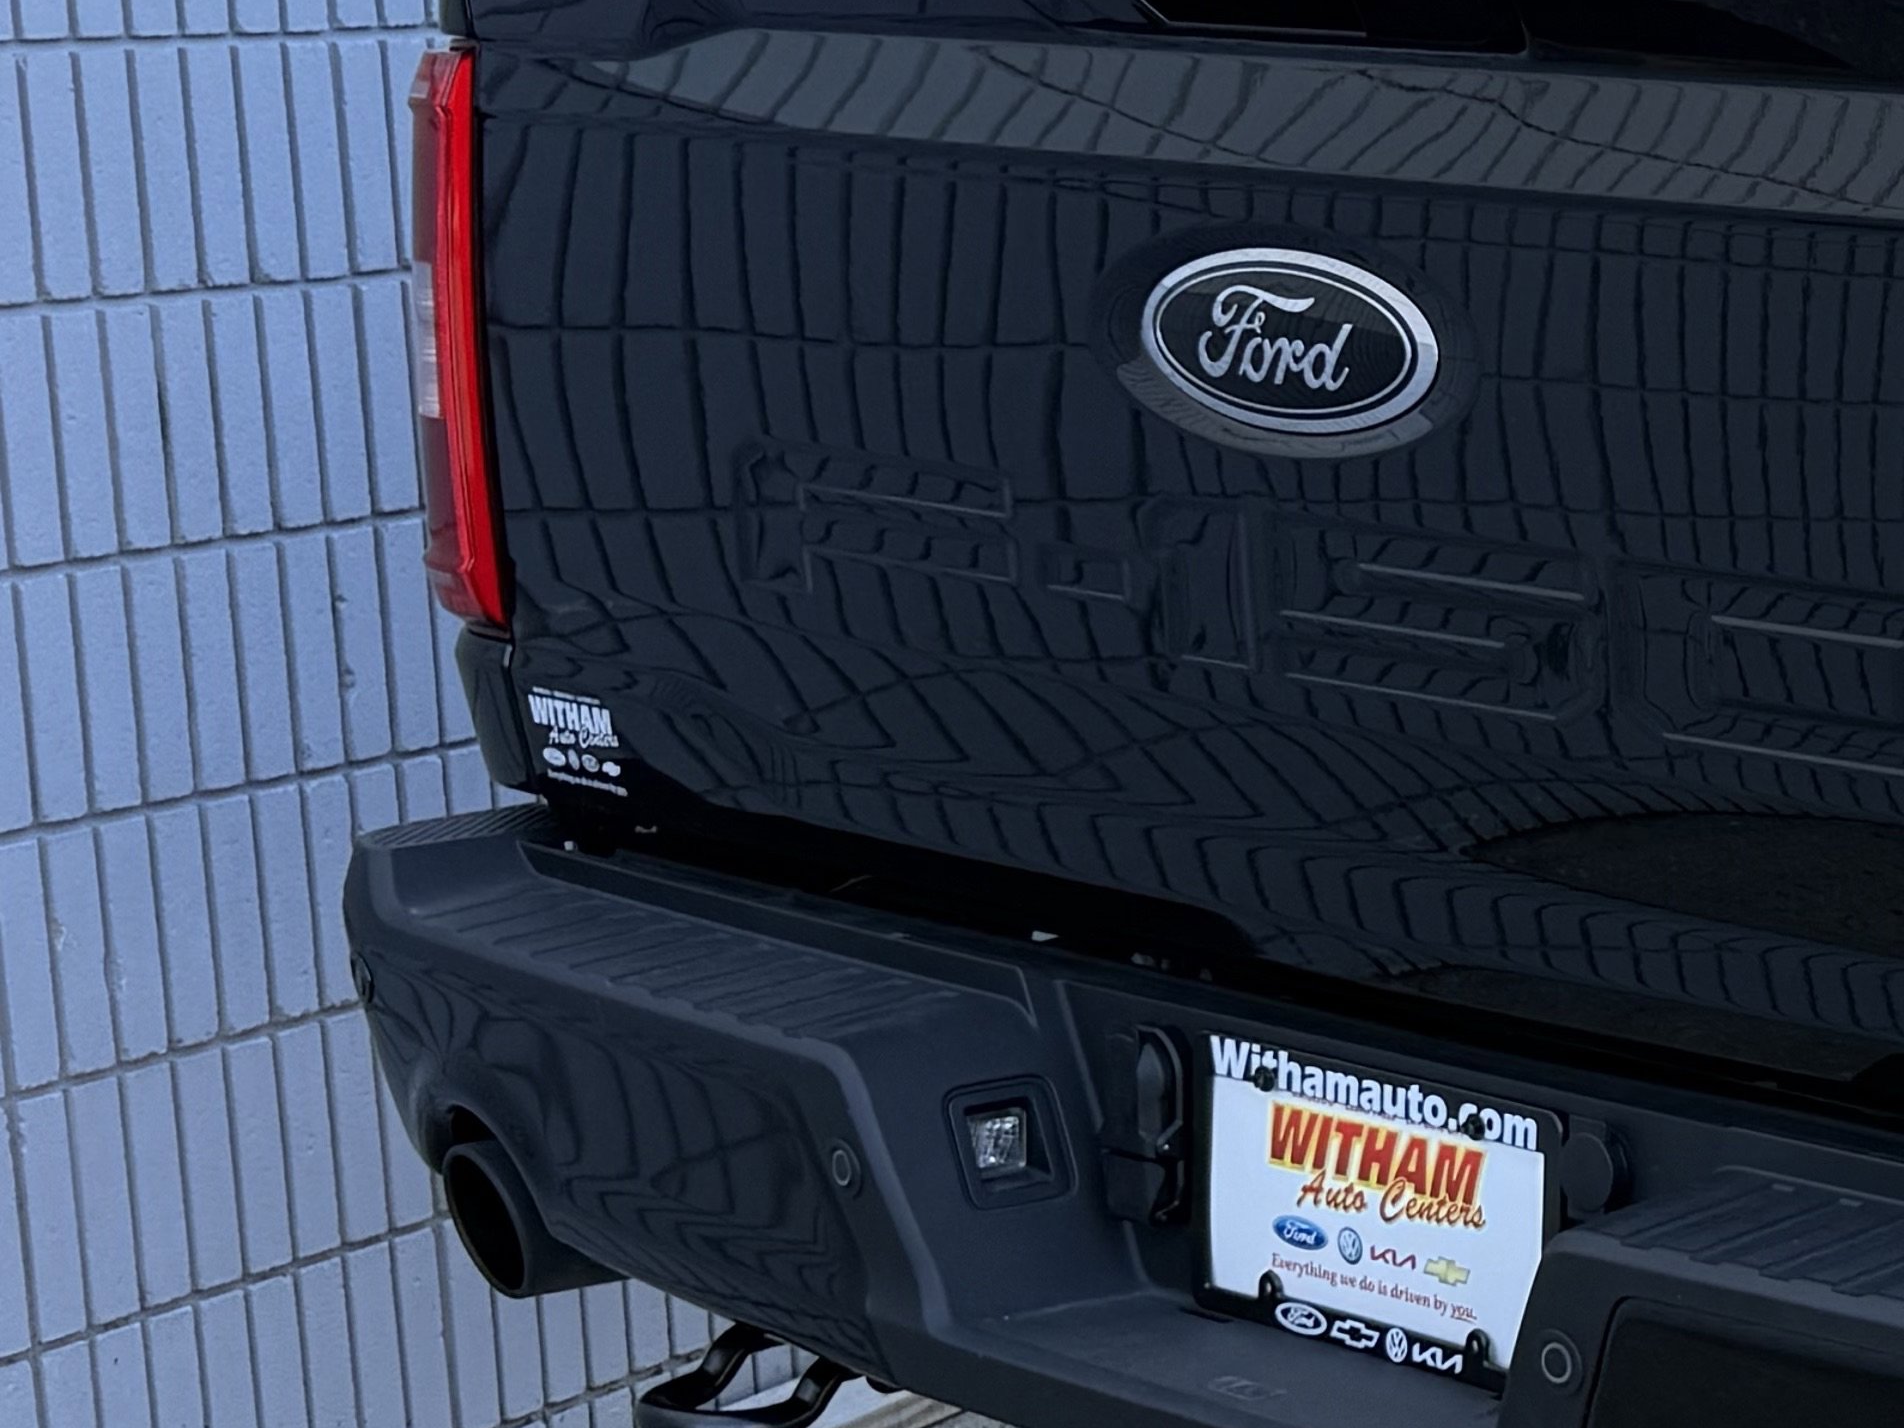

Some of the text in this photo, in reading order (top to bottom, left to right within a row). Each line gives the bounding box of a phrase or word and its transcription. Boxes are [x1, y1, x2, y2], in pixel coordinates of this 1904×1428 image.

[1198, 284, 1353, 392] Ford
[528, 694, 613, 736] WITHAM
[1210, 1034, 1538, 1152] Withamauto.com
[1267, 1102, 1486, 1207] WITHAM
[1296, 1170, 1487, 1229] Auto Centers
[1272, 1252, 1478, 1320] Everything we do is driven by you.
